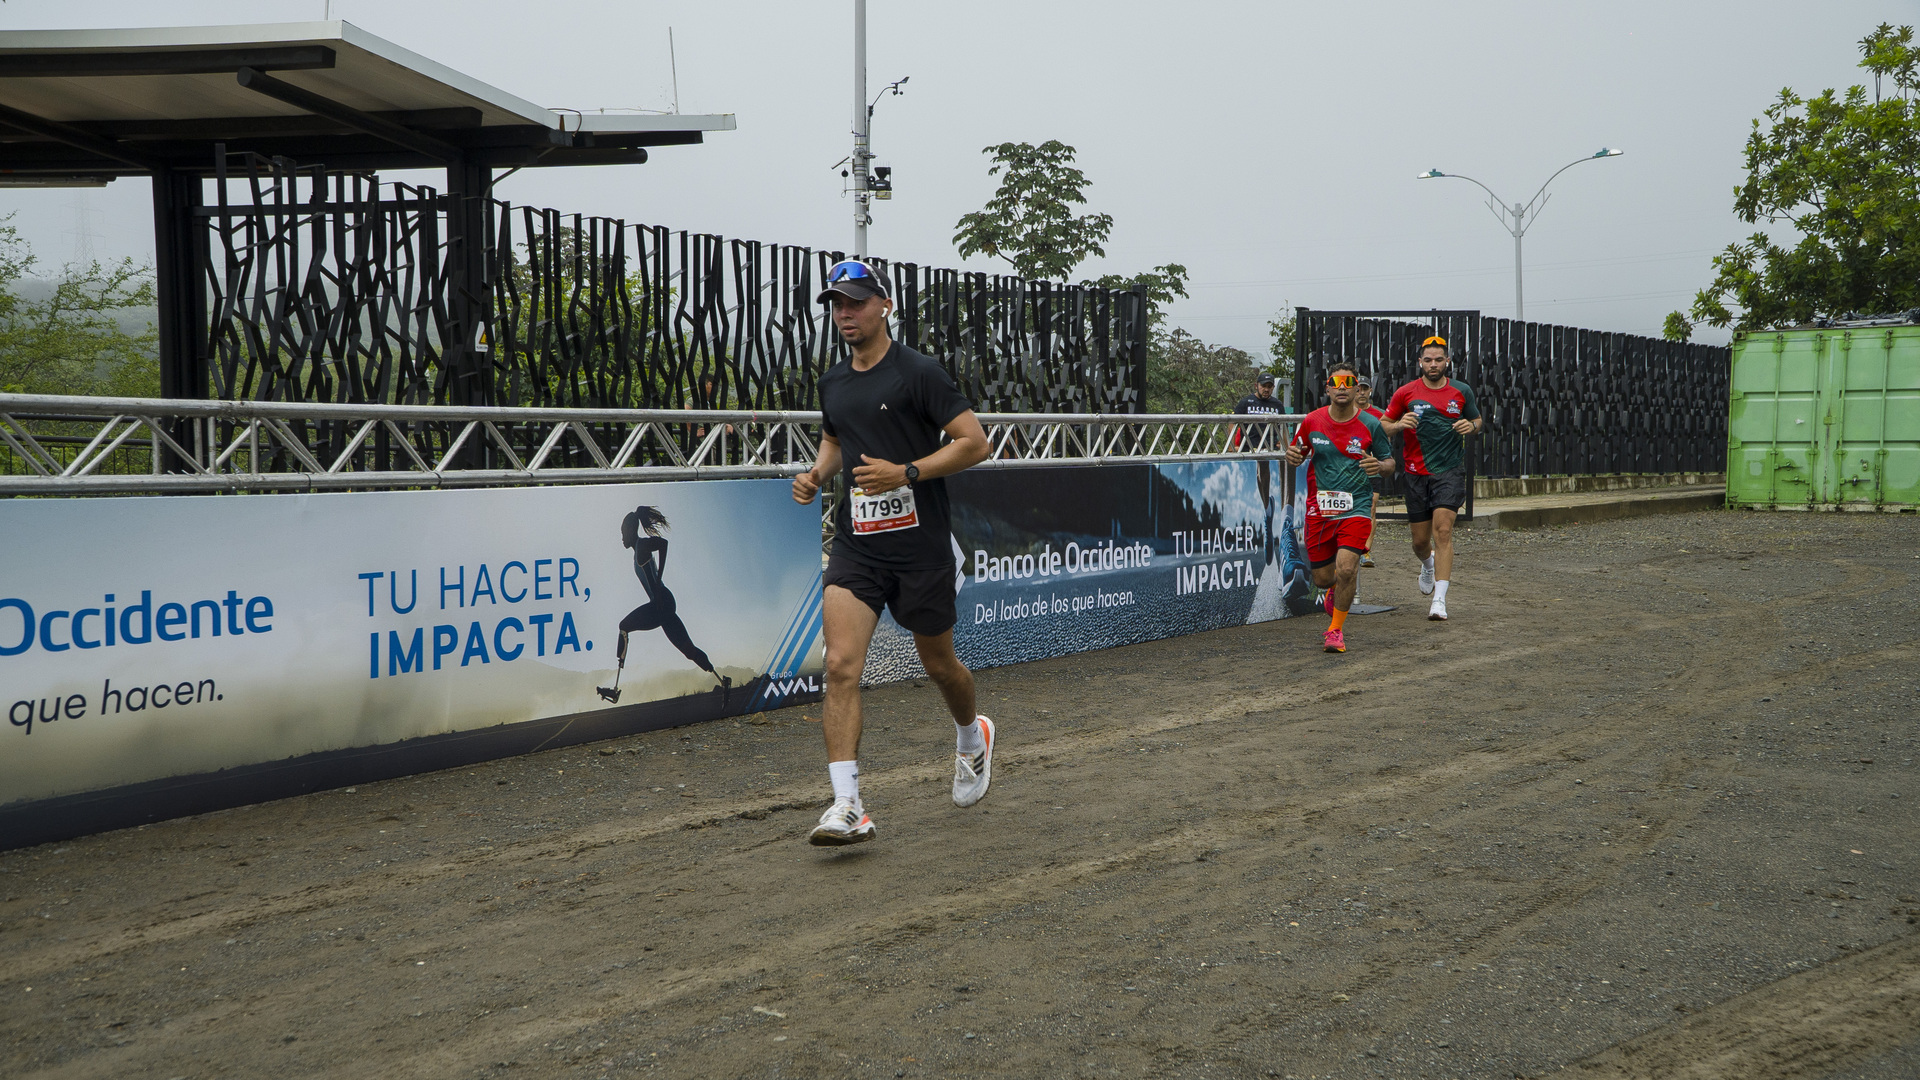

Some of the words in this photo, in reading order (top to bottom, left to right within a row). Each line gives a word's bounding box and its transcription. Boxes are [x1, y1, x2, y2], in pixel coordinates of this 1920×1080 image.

[859, 498, 903, 518] 1799
[1320, 499, 1346, 509] 1165
[1172, 530, 1194, 558] TU
[1201, 525, 1258, 555] HACER,
[974, 550, 1034, 583] Banco
[1038, 544, 1061, 577] de
[1065, 539, 1151, 574] Occidente
[1176, 559, 1259, 595] IMPACTA.
[358, 569, 417, 617] TU
[440, 557, 591, 609] HACER,
[0, 590, 274, 656] Occidente
[975, 600, 997, 624] Del
[1000, 597, 1029, 621] lado
[1031, 594, 1048, 616] de
[1051, 593, 1068, 614] los
[1071, 595, 1093, 616] que
[1098, 588, 1135, 609] hacen.
[370, 611, 593, 679] IMPACTA.
[763, 675, 819, 699] AVAL
[770, 671, 793, 680] Grupo
[9, 693, 87, 735] que
[101, 678, 224, 715] hacen.
